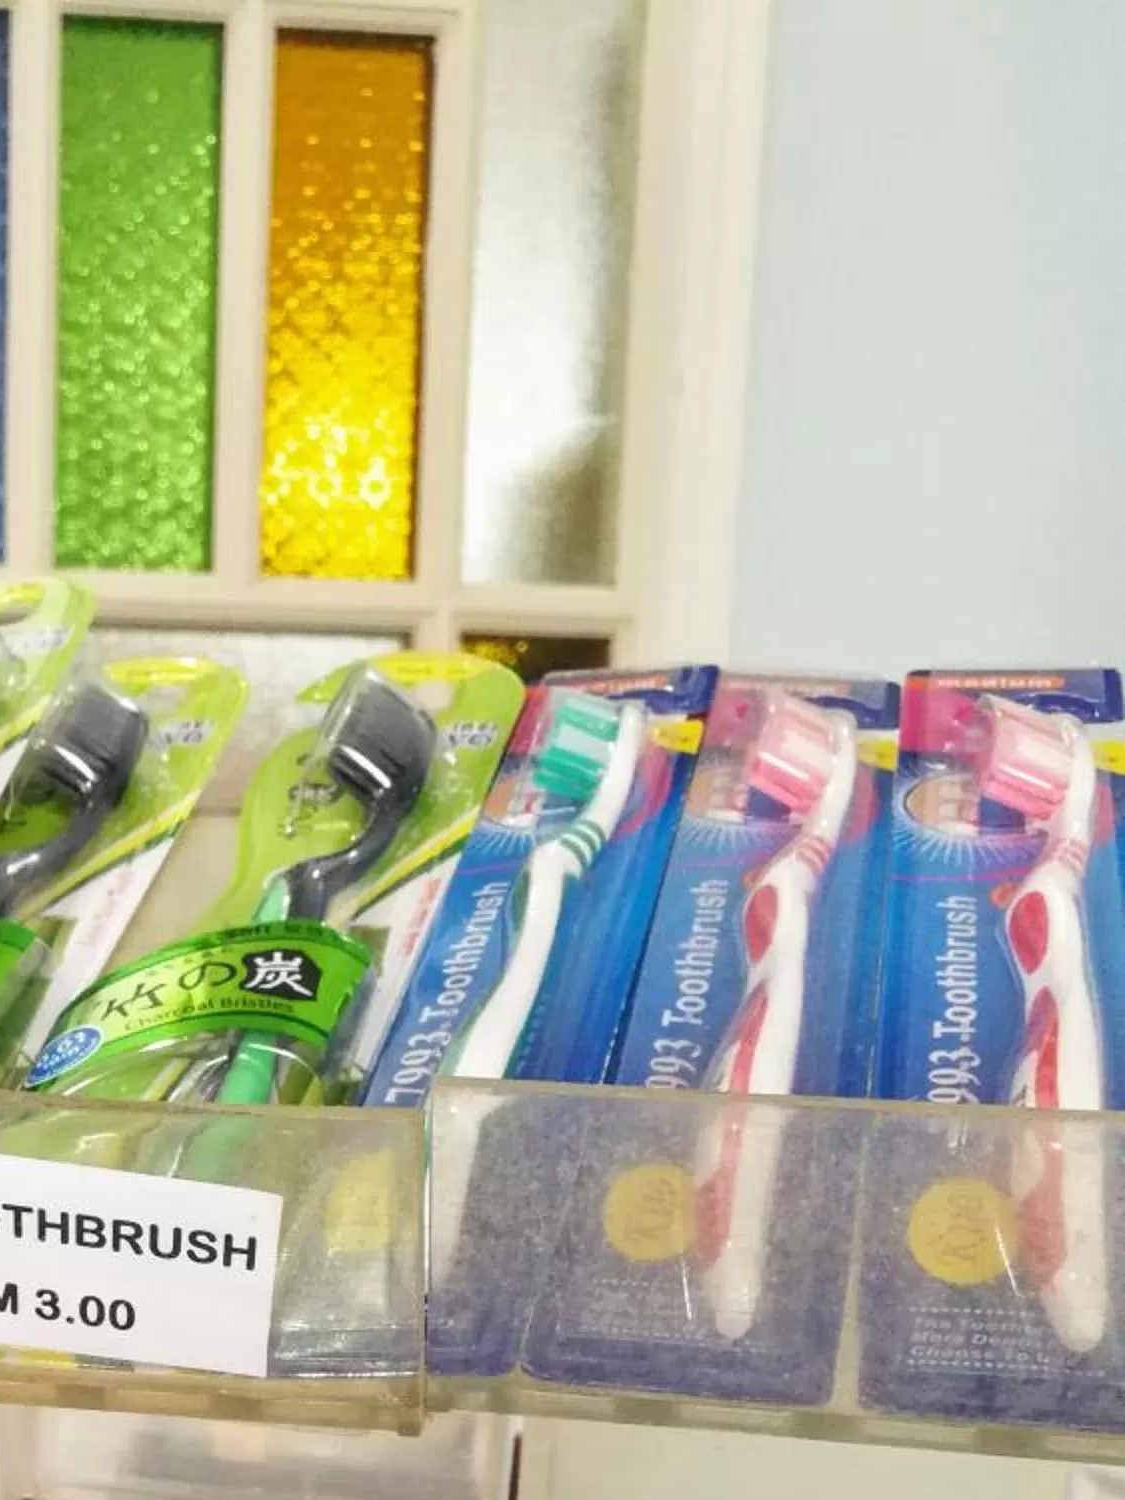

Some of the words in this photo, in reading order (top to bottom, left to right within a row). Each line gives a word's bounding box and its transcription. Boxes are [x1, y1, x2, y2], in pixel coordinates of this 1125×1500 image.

[101, 950, 315, 1020] 竹の炭
[663, 880, 727, 1024] Toothbrush
[934, 897, 976, 1040] Toothbrush
[386, 1031, 450, 1110] 7993
[420, 884, 503, 1028] Toothbrush
[646, 1040, 699, 1096] 993
[928, 1049, 979, 1105] 993
[34, 1289, 136, 1330] 3.00
